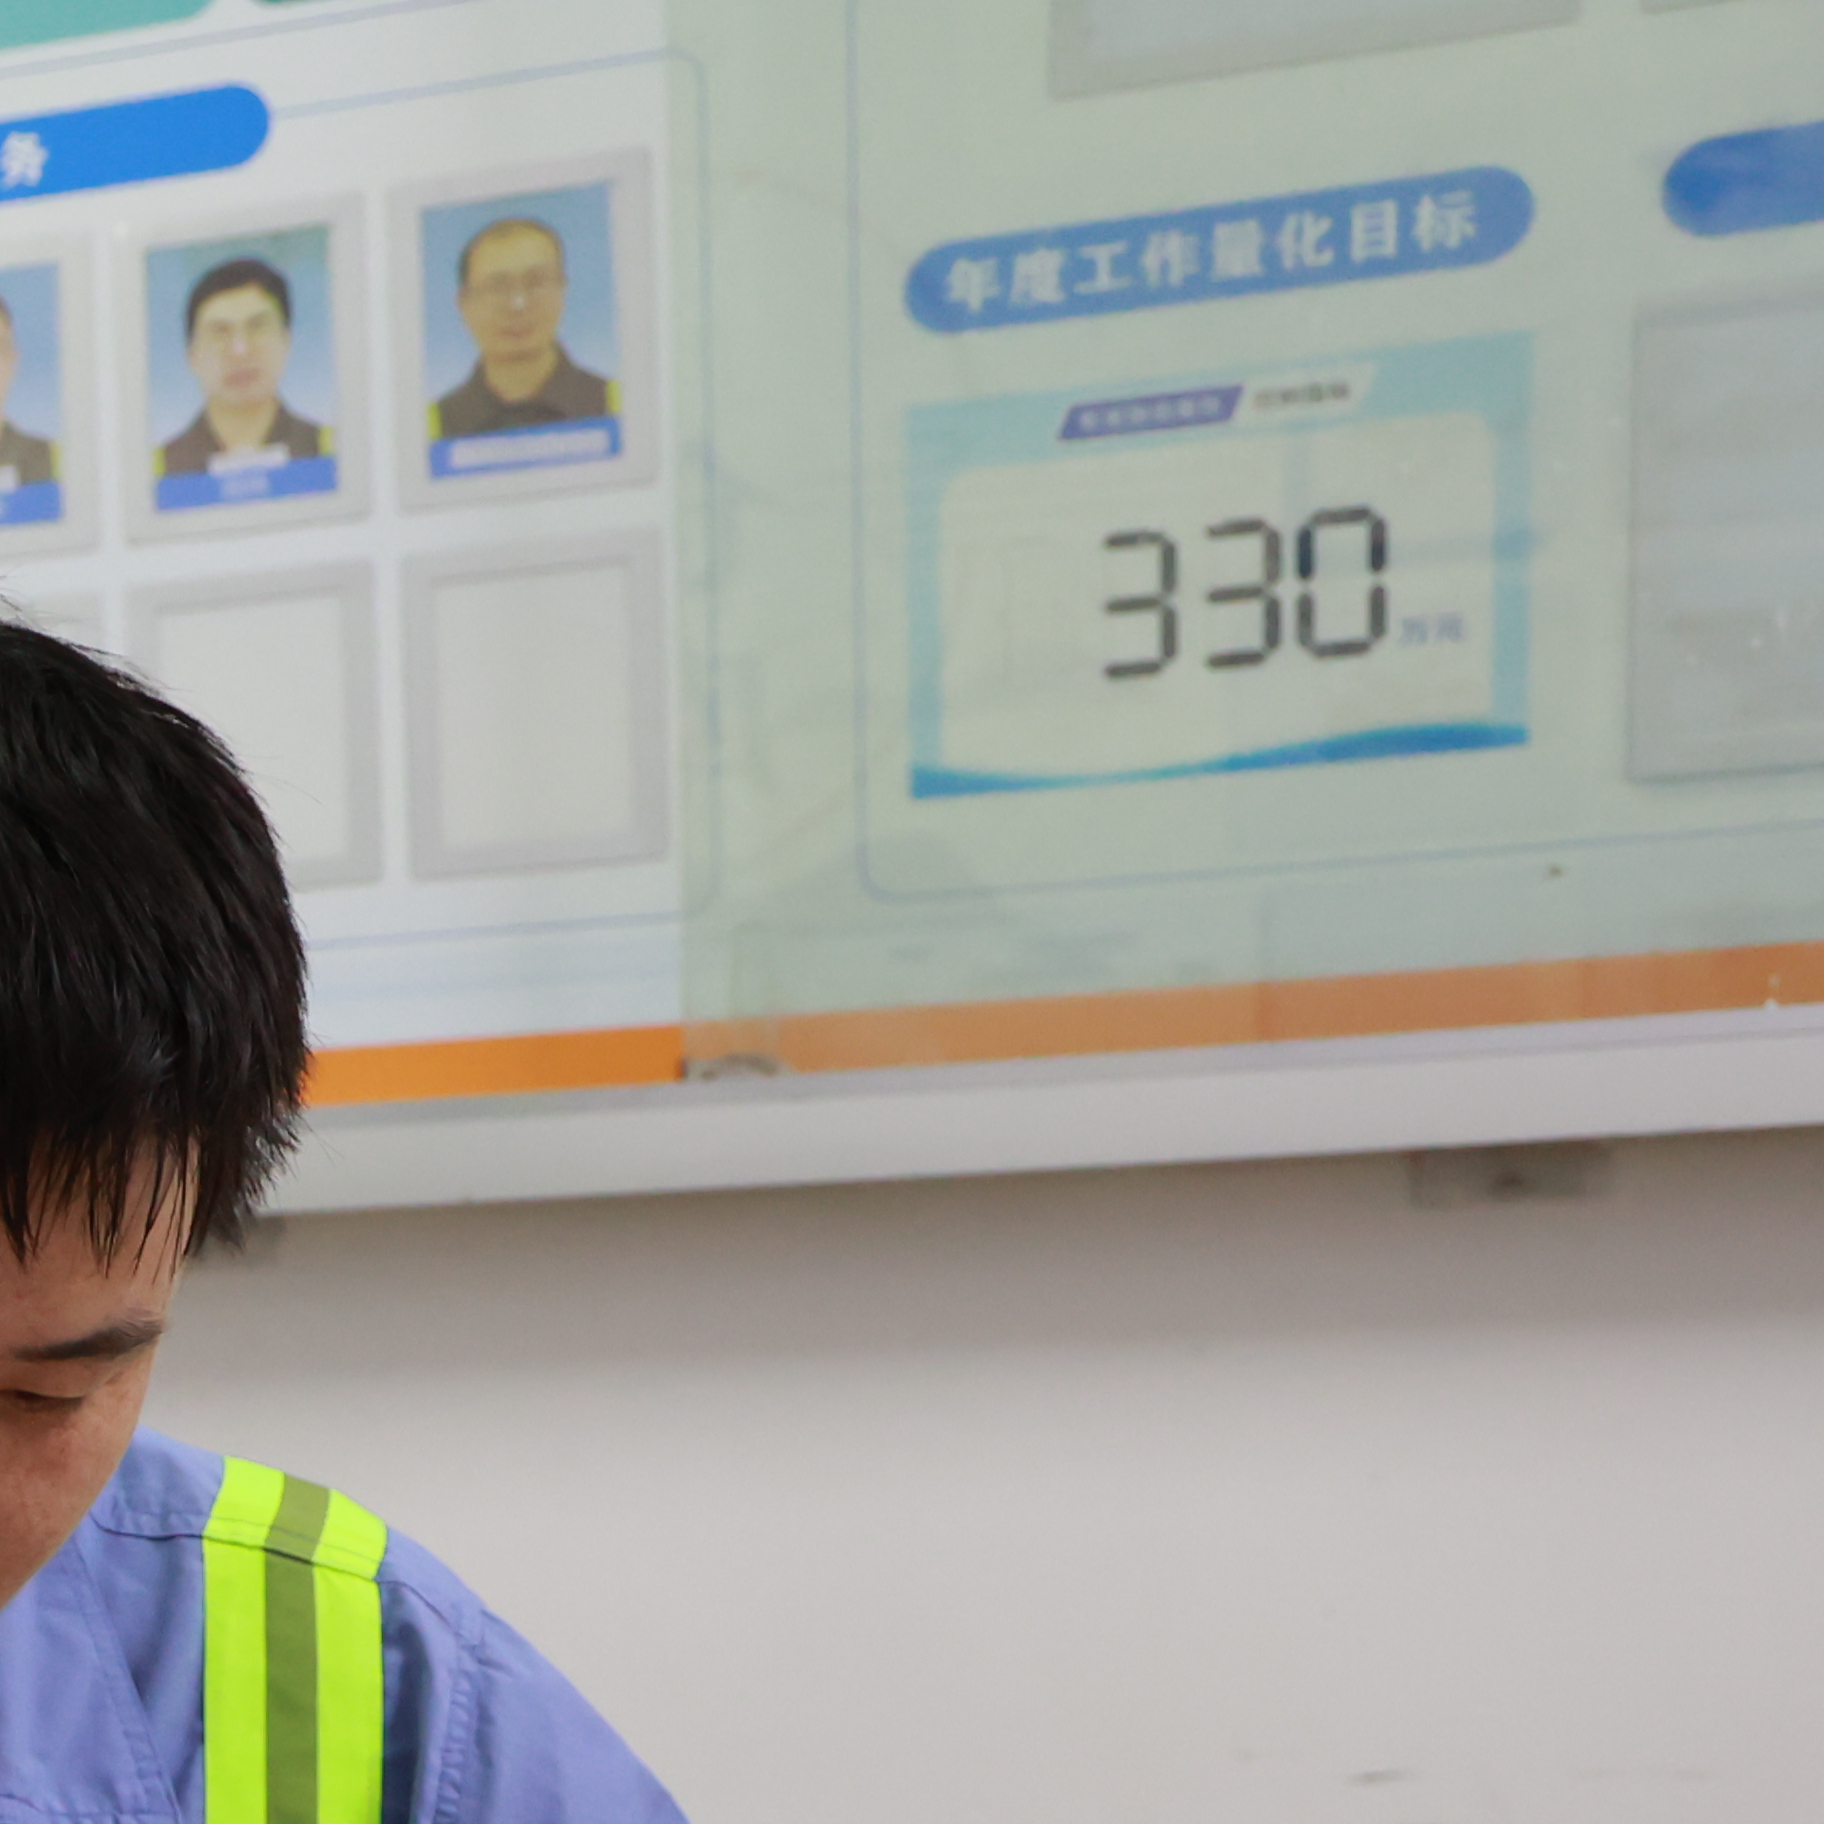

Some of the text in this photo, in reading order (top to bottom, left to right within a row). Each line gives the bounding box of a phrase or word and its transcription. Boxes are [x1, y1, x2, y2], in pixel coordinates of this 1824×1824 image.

[946, 190, 1476, 314] 年度工作量化目标
[1104, 504, 1388, 680] 330
